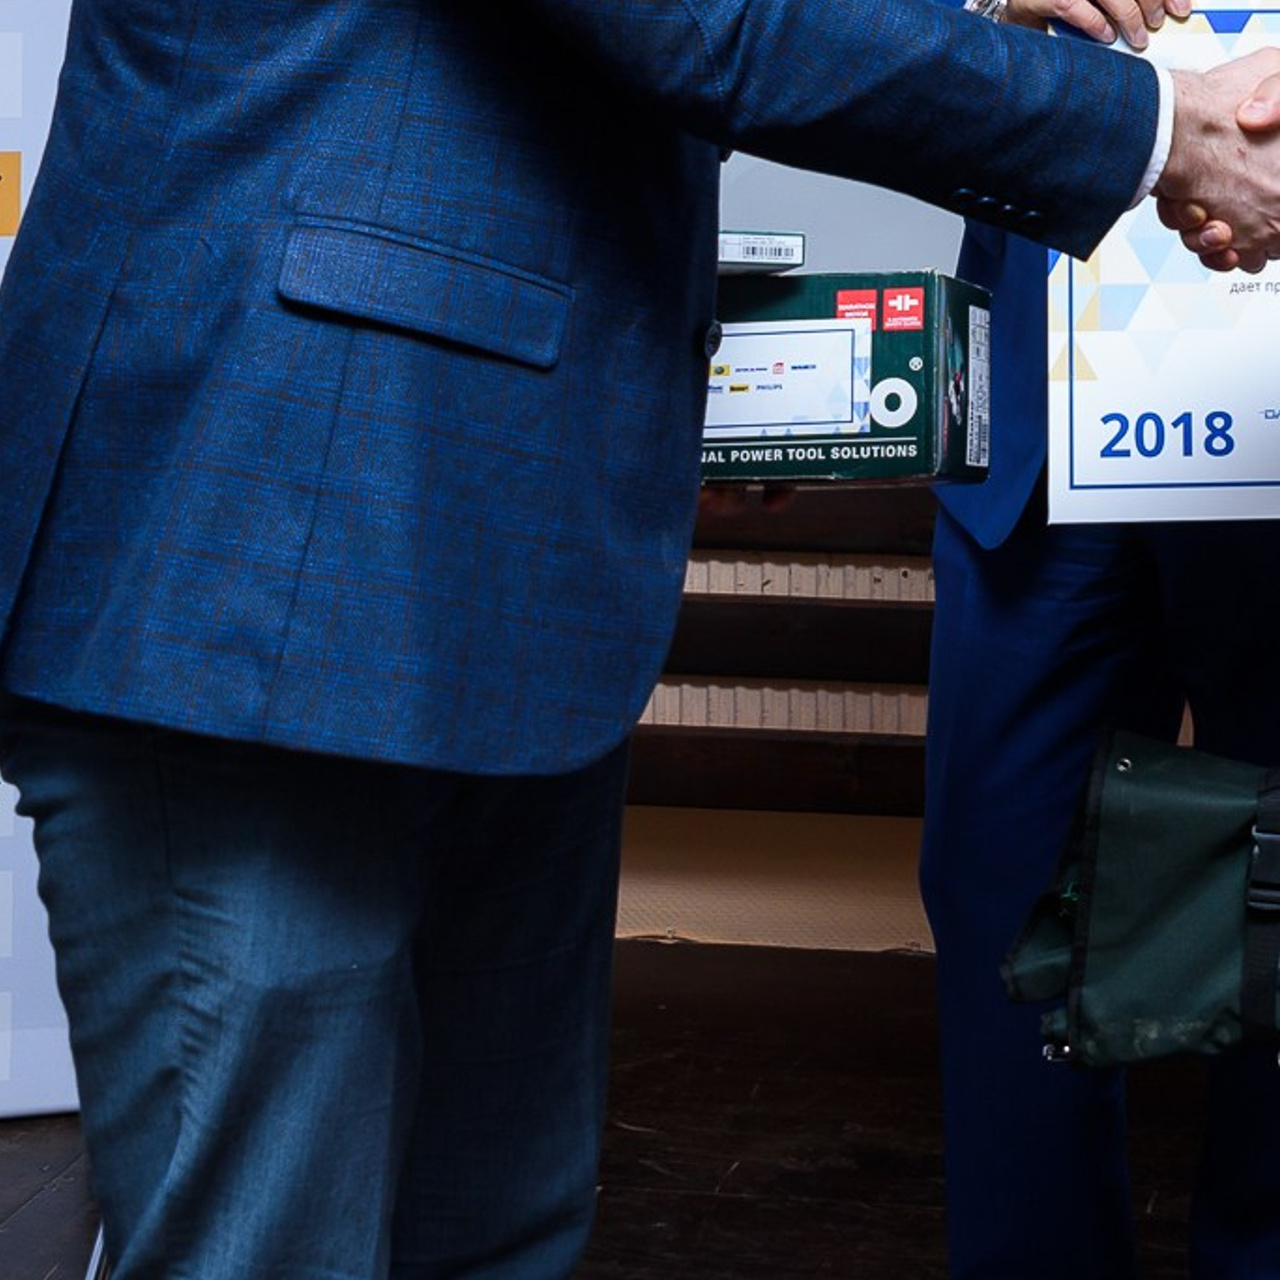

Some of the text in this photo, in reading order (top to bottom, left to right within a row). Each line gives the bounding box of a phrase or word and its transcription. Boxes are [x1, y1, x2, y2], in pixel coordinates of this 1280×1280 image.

[1229, 281, 1261, 294] дает
[1100, 411, 1235, 458] 2018
[731, 448, 783, 462] POWER
[787, 447, 826, 461] TOOL
[831, 444, 918, 460] SOLUTIONS
